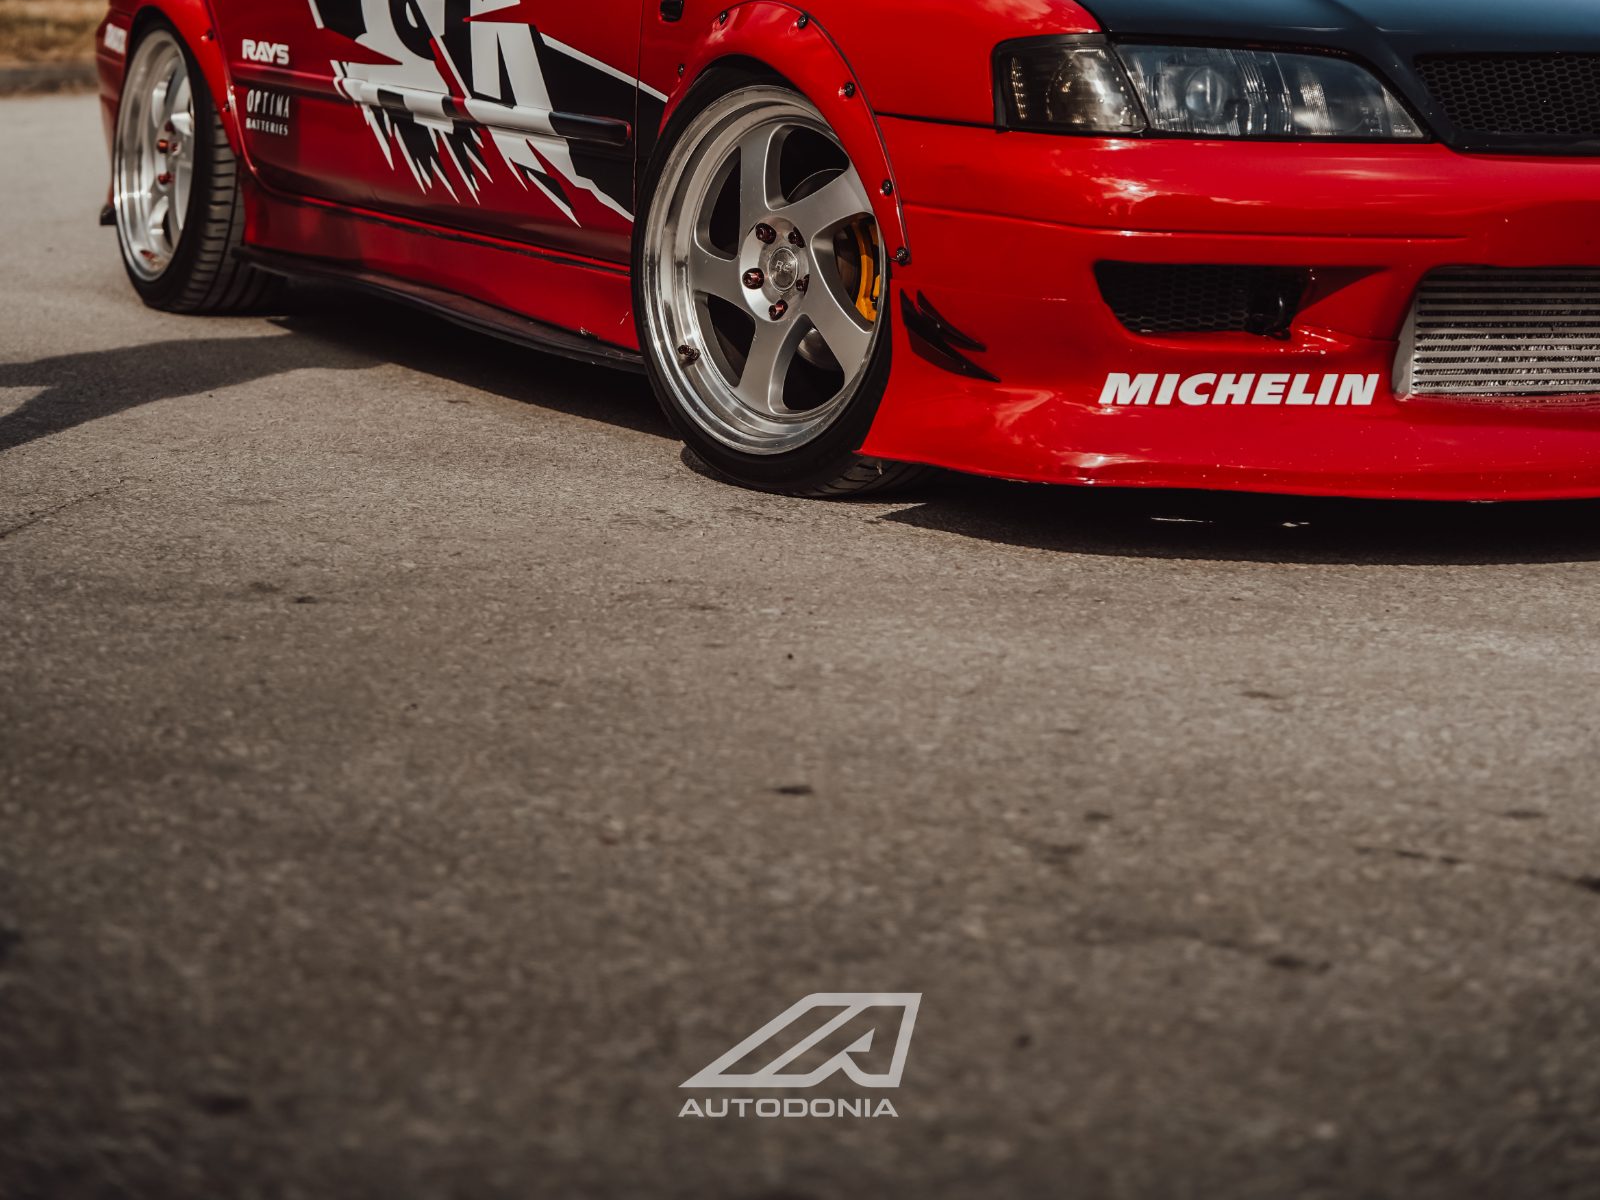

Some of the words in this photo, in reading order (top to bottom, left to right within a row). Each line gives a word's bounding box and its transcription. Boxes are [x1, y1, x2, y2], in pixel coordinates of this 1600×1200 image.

[242, 39, 289, 65] RAYS
[246, 89, 290, 118] OPTIMA
[245, 118, 288, 136] BATTERIES
[1098, 372, 1380, 406] MICHELIN
